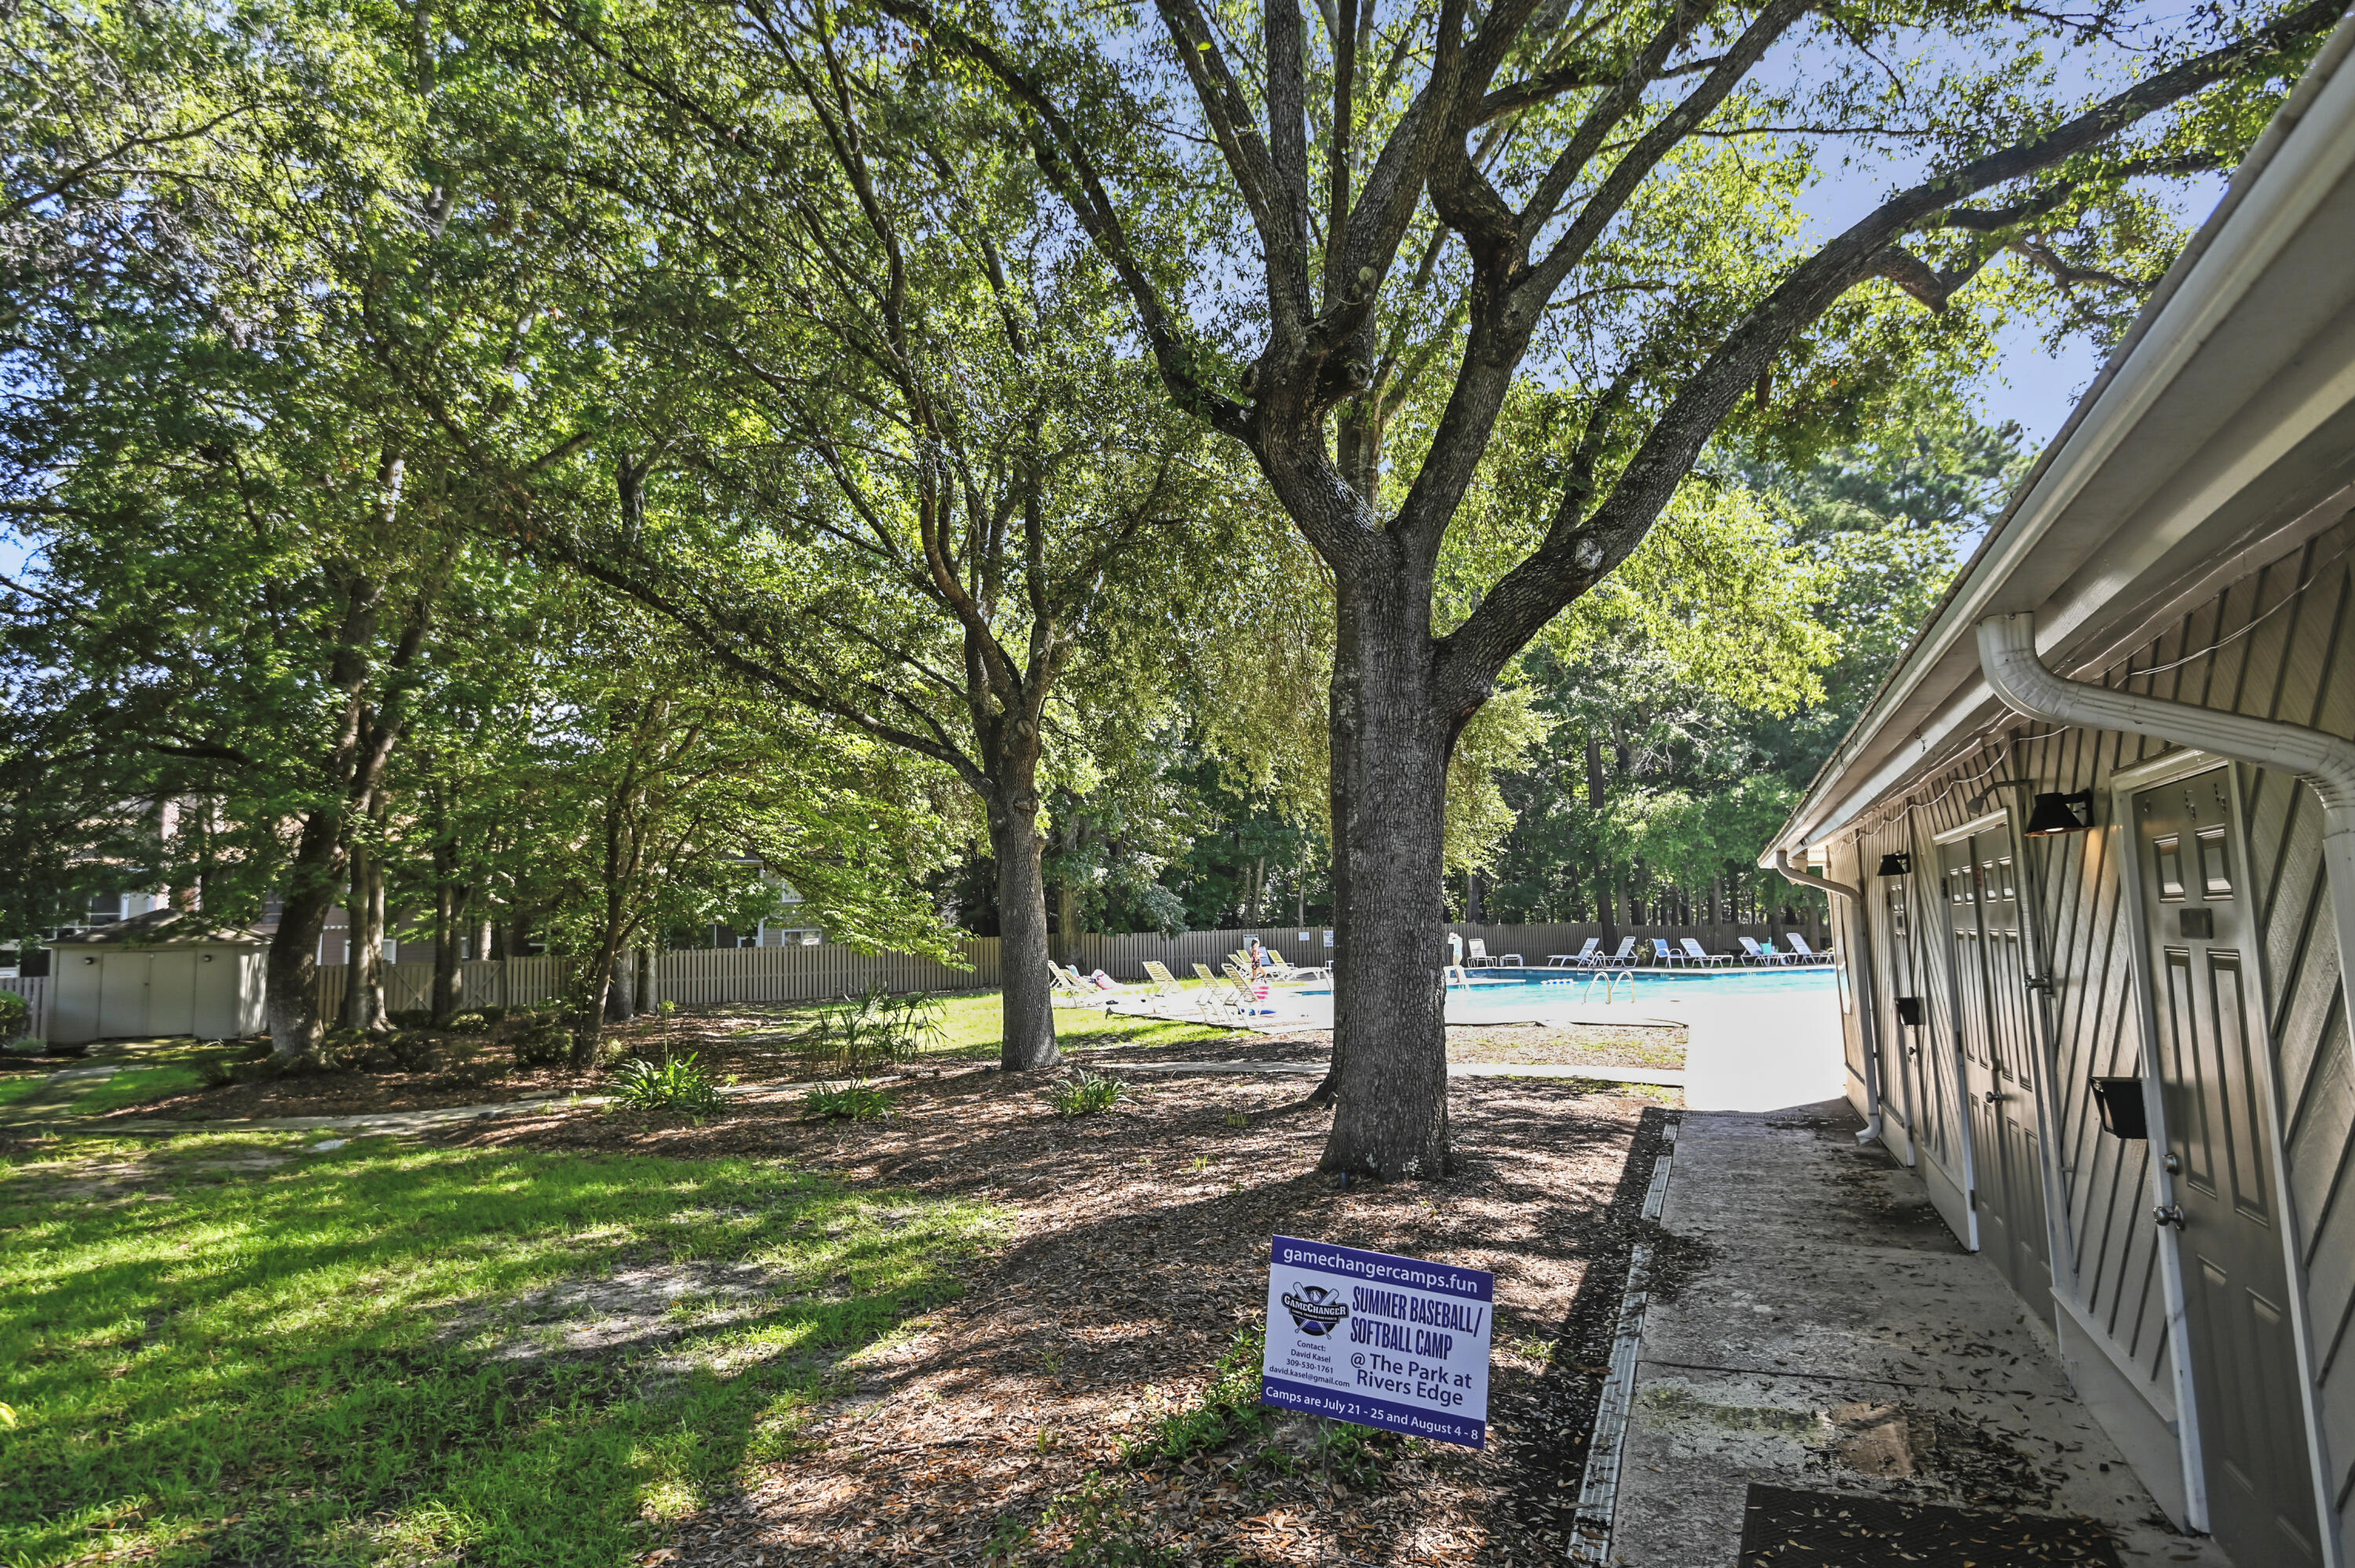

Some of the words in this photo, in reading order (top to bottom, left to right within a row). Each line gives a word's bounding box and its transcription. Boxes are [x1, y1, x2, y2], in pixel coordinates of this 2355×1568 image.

[1283, 1248, 1477, 1293] gamechangercamps.fun
[1352, 1285, 1408, 1321] SUMMER
[1409, 1296, 1483, 1337] BASEBALL/
[1291, 1348, 1311, 1359] David
[1313, 1353, 1331, 1363] Kasel
[1297, 1340, 1326, 1352] Contact:
[1350, 1316, 1412, 1354] SOFTBALL
[1415, 1329, 1453, 1360] CAMP
[1269, 1365, 1350, 1387] david.kasel@gmail.com
[1286, 1358, 1334, 1374] 309-530-1761
[1350, 1352, 1366, 1369] @
[1369, 1353, 1403, 1375] The
[1408, 1361, 1449, 1384] Park
[1453, 1373, 1473, 1389] at
[1356, 1369, 1411, 1395] Rivers
[1416, 1380, 1463, 1407] Edge
[1265, 1386, 1302, 1403] Camps
[1304, 1396, 1321, 1407] are
[1323, 1398, 1345, 1414] July
[1347, 1403, 1360, 1415] 21
[1370, 1408, 1385, 1420] 25
[1386, 1413, 1408, 1425] and
[1411, 1416, 1451, 1435] August
[1454, 1426, 1462, 1436] 4
[1470, 1429, 1479, 1440] 8
